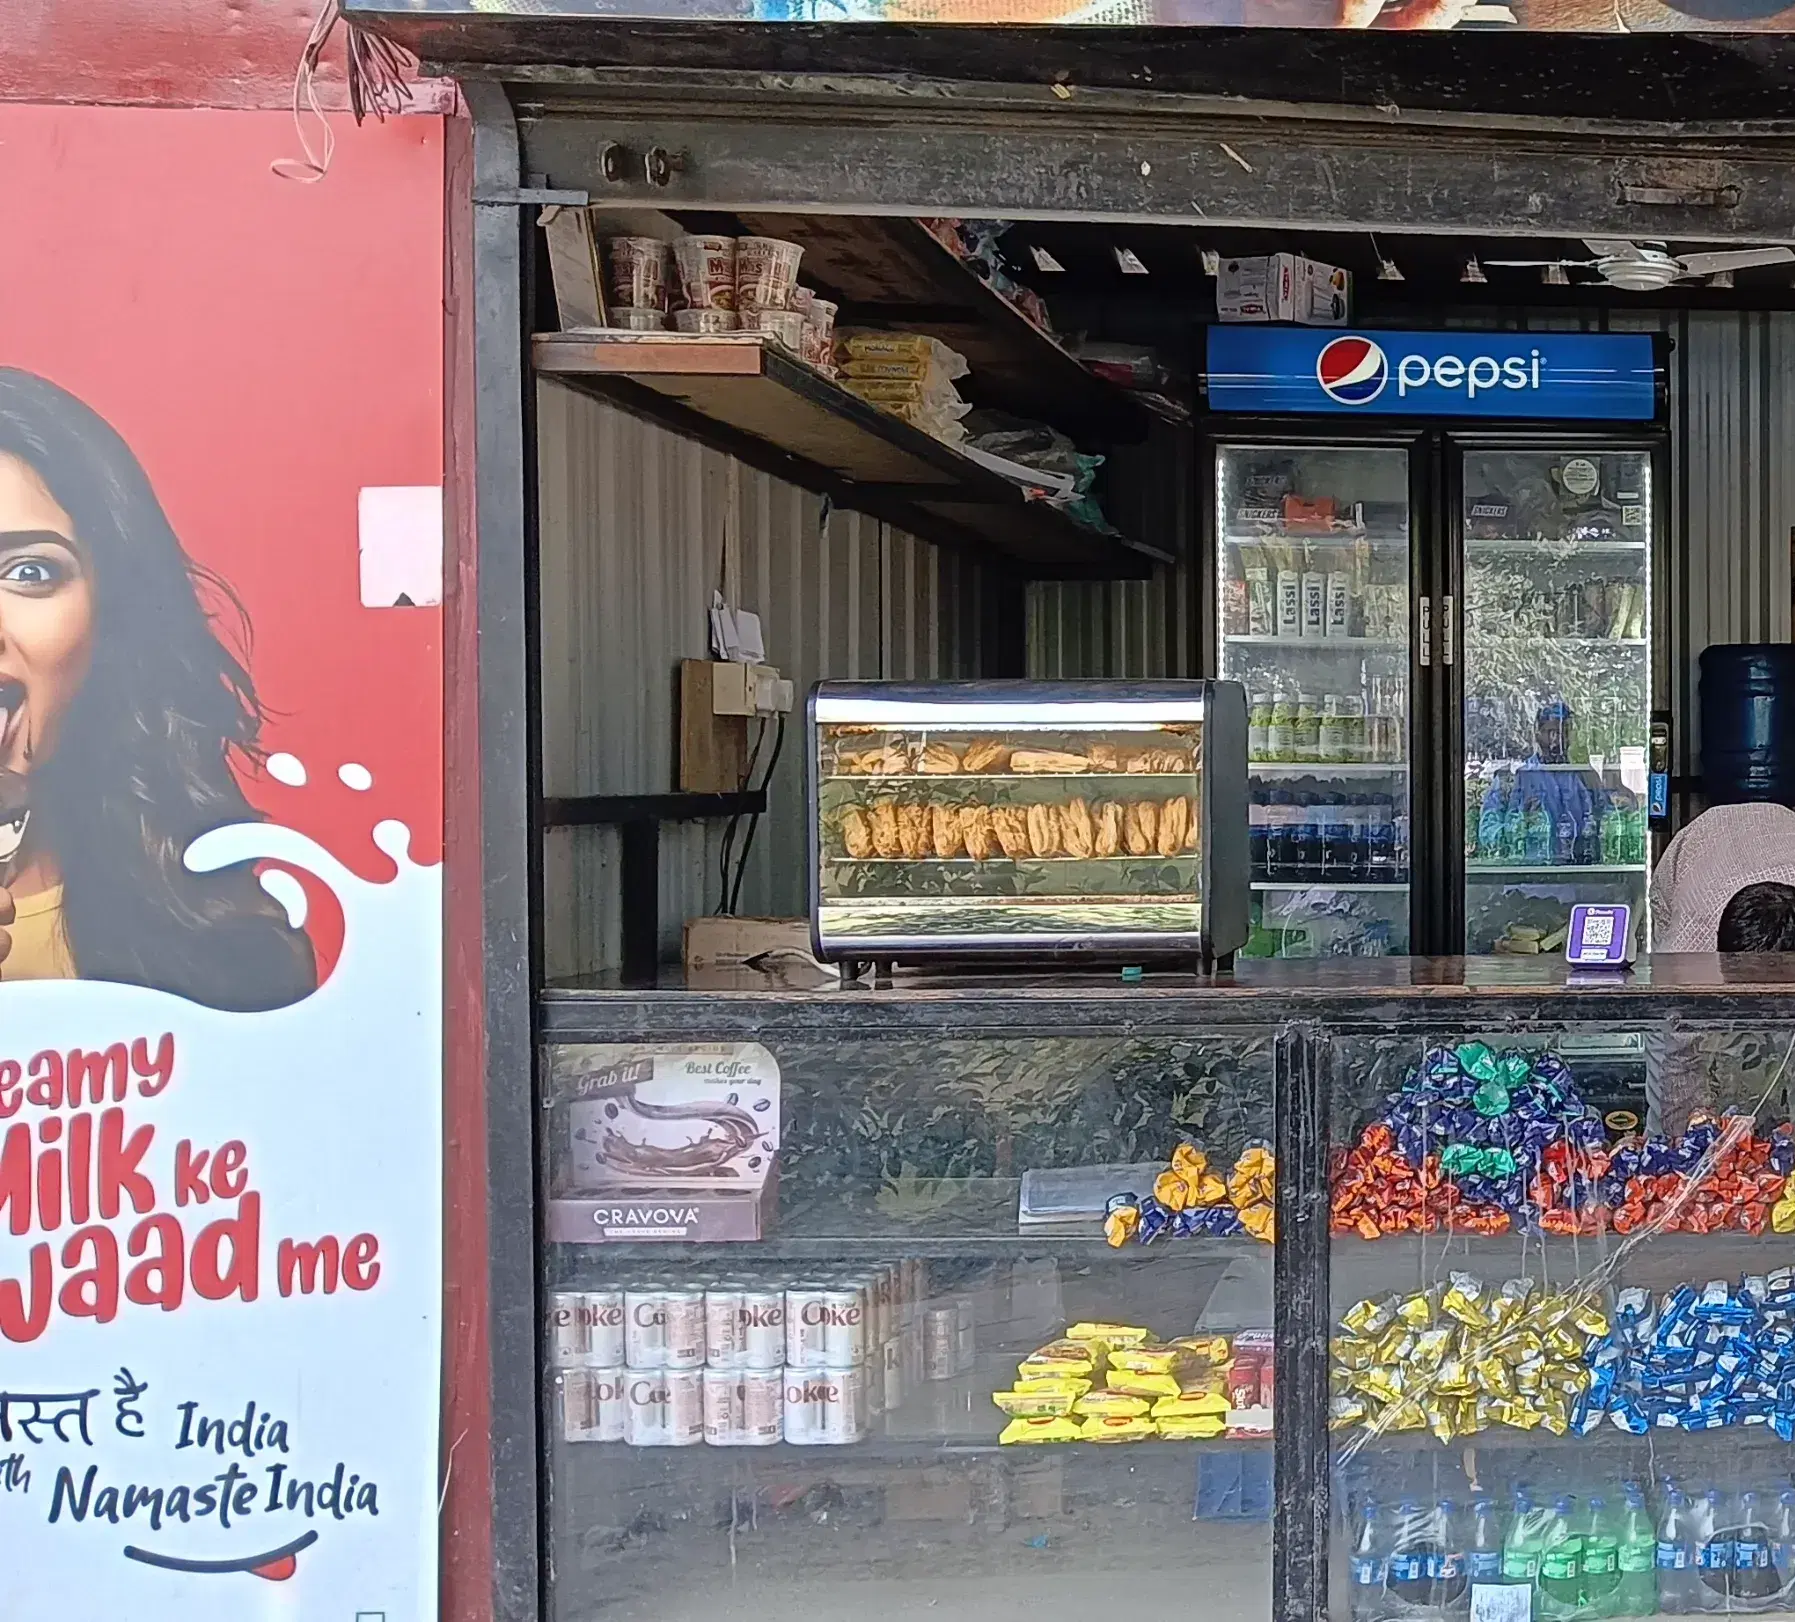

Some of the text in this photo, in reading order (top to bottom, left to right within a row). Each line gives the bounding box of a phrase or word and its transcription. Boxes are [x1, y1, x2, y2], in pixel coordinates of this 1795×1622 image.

[1398, 349, 1540, 398] pepsi
[1283, 584, 1296, 625] Lassi
[1307, 585, 1320, 626] Lassi
[1331, 586, 1345, 626] Lassi
[577, 1063, 642, 1096] Grab it!
[685, 1060, 752, 1078] Best Coffee
[175, 1139, 249, 1207] ke
[593, 1207, 699, 1226] CRAVOVA
[278, 1232, 381, 1298] me
[175, 1400, 290, 1457] India
[48, 1463, 259, 1531] Namaste
[264, 1462, 380, 1517] India
